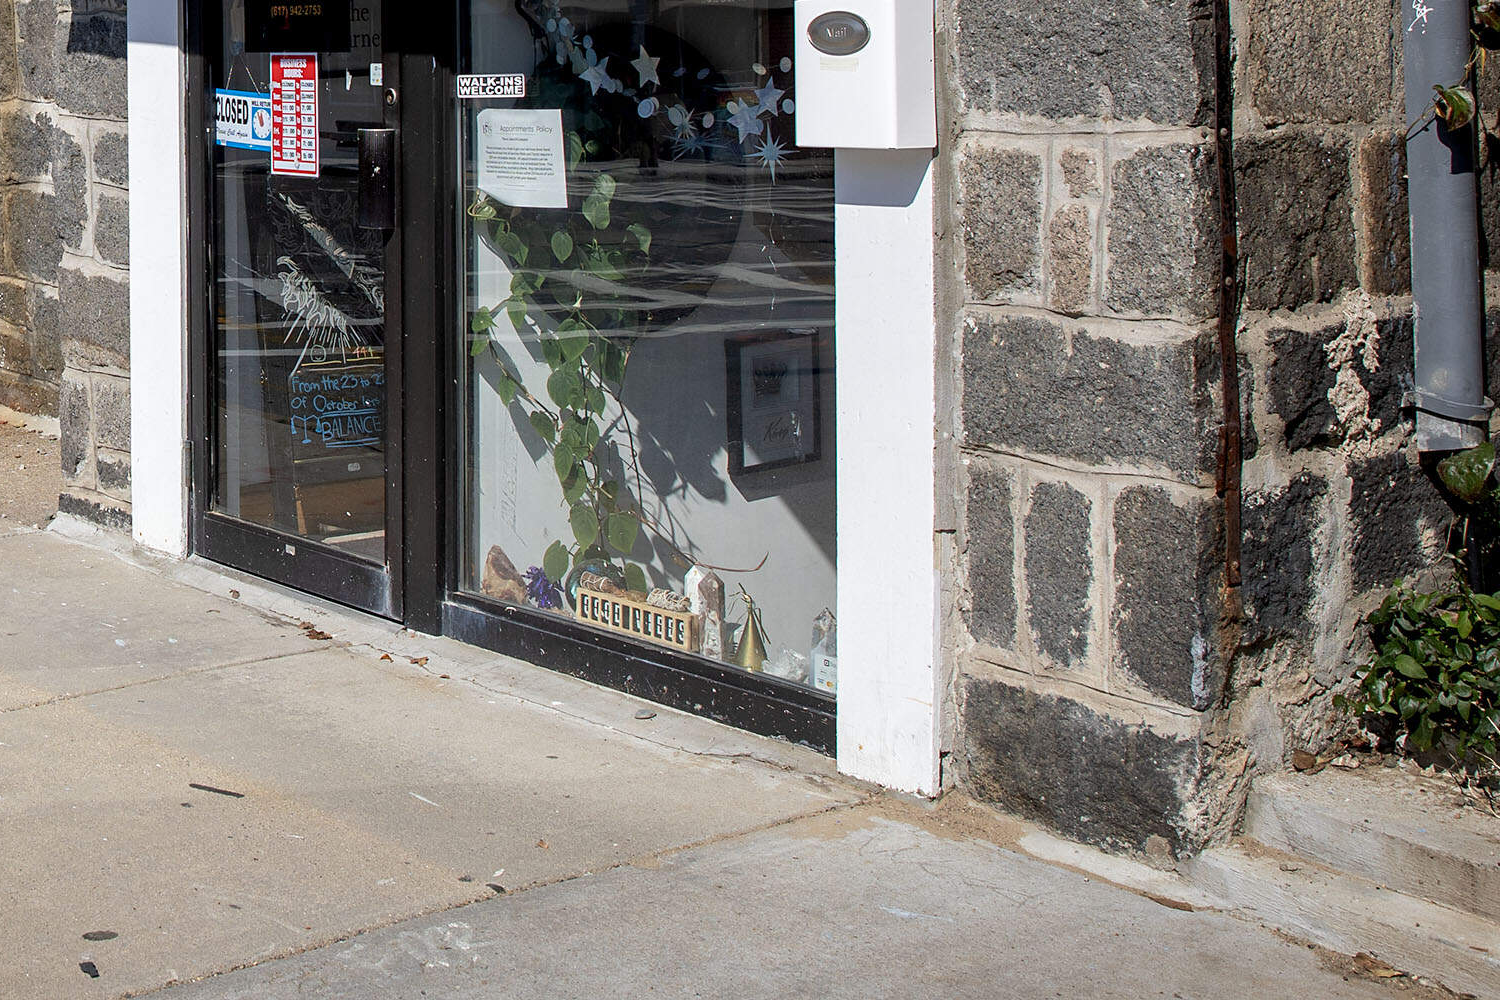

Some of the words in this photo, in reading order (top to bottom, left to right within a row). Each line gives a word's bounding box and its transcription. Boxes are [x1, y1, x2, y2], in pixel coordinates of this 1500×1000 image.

[270, 5, 288, 17] (617)
[289, 4, 322, 16] 942-2753
[460, 76, 523, 87] WALK-INS
[460, 86, 523, 95] WELCOME
[215, 95, 249, 126] CLOSED
[499, 125, 534, 134] Appointments
[535, 125, 553, 135] Policy
[292, 376, 320, 393] From
[321, 375, 341, 391] the
[360, 376, 370, 388] to
[313, 395, 358, 412] October
[321, 415, 382, 442] BALANCE
